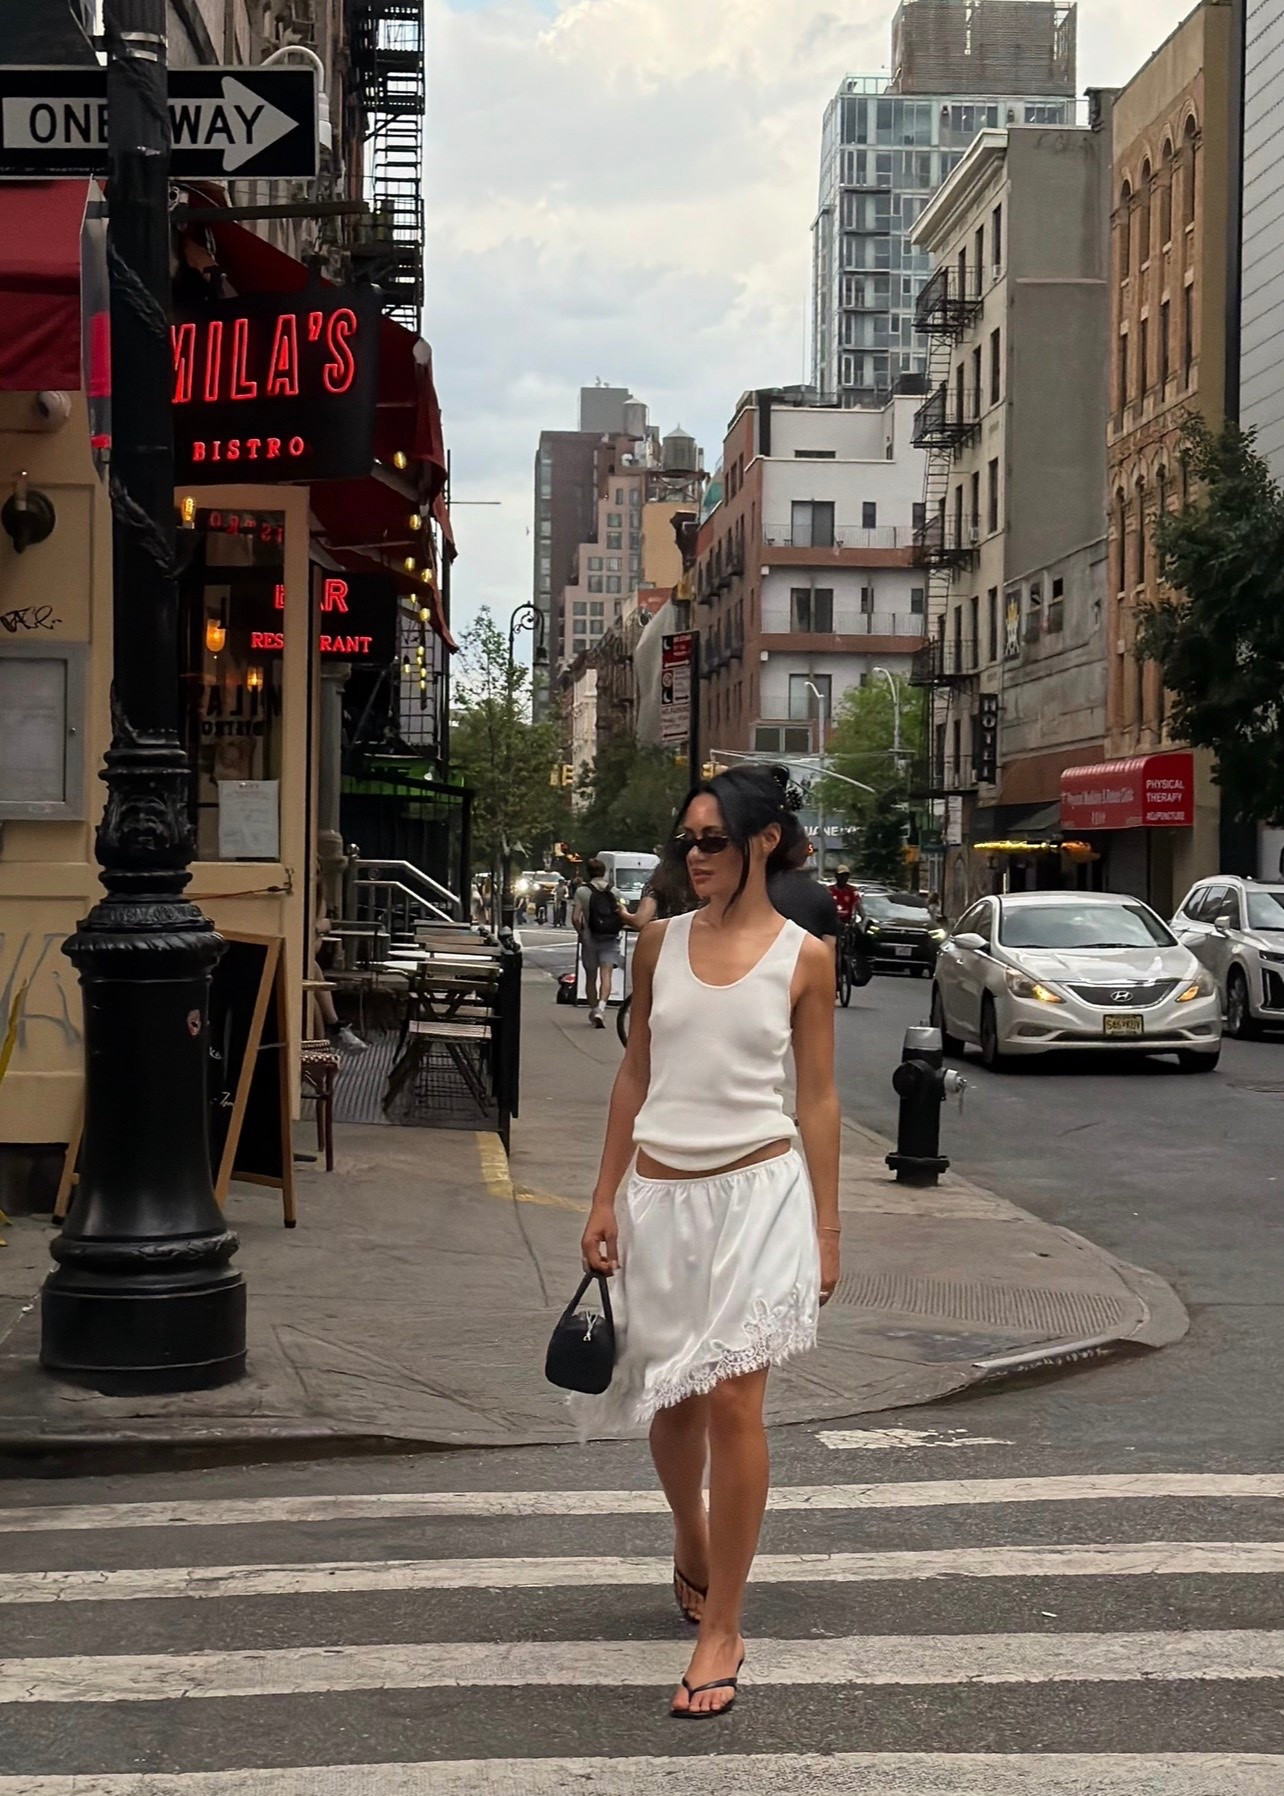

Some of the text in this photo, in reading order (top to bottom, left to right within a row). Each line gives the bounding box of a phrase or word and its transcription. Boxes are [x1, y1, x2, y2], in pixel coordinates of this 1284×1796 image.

[168, 104, 265, 144] WAY
[193, 436, 304, 460] BISTRO
[1146, 779, 1184, 789] PHYSICAL
[1146, 792, 1182, 802] THERAPY
